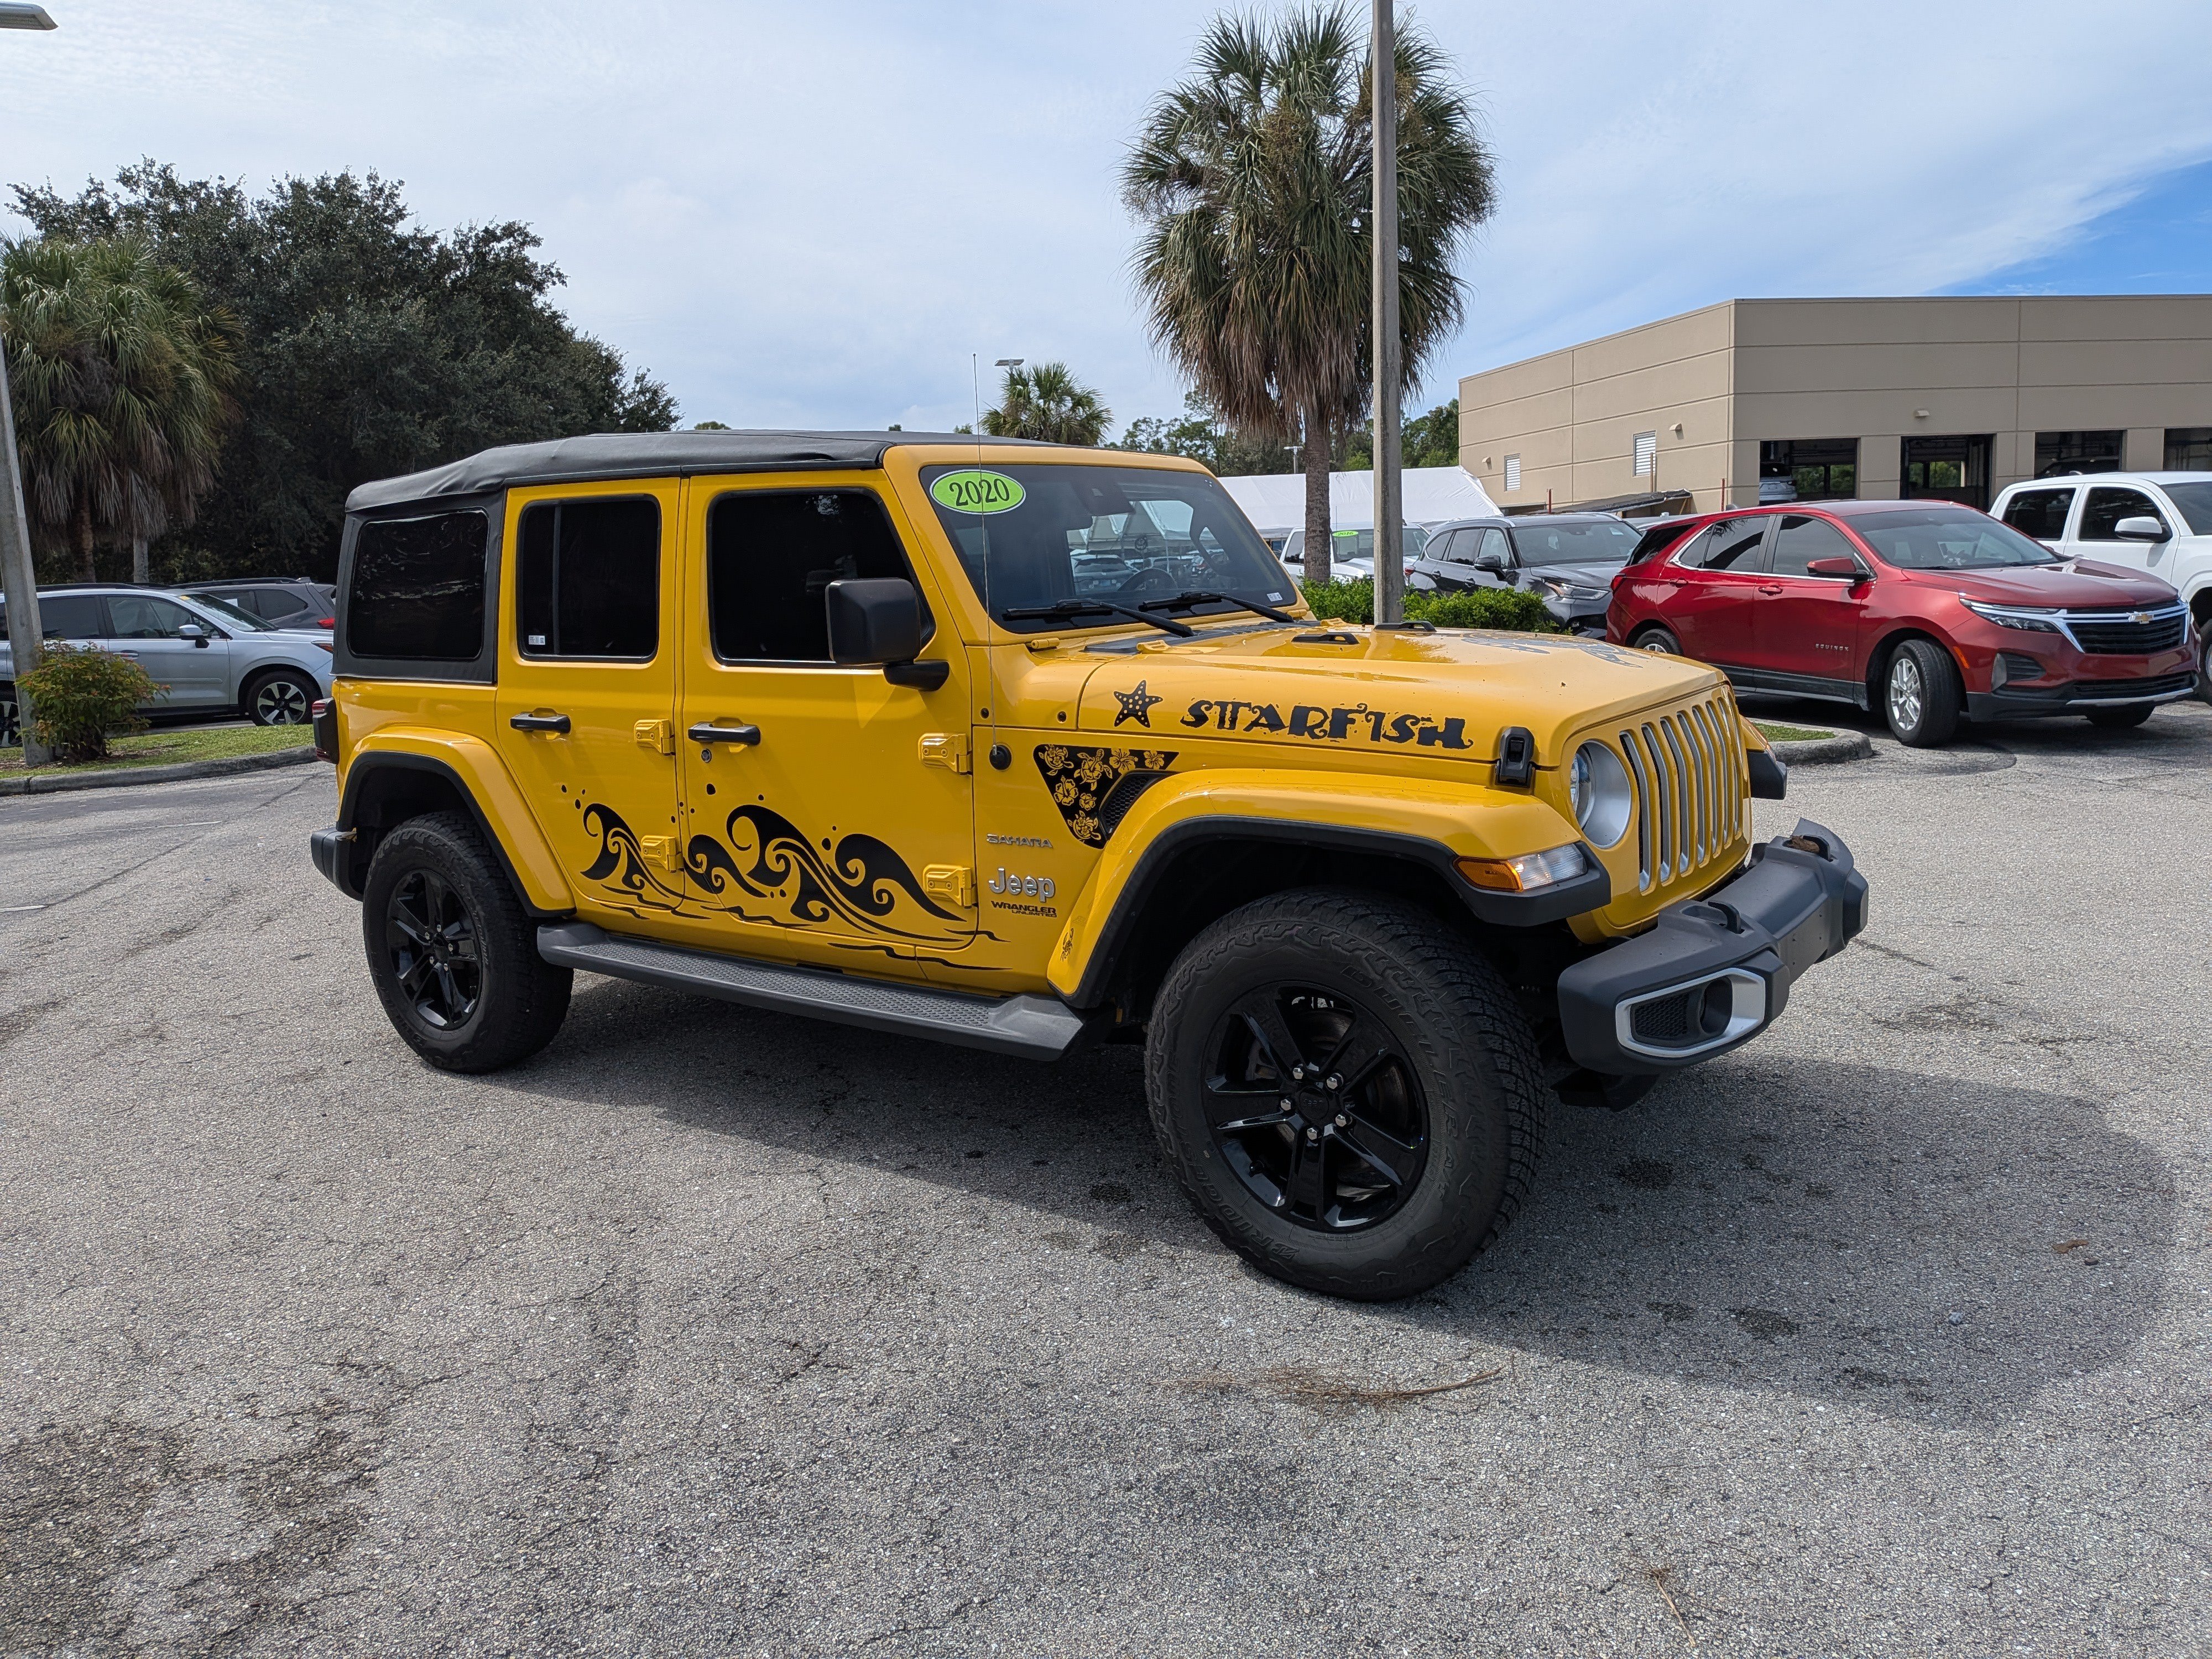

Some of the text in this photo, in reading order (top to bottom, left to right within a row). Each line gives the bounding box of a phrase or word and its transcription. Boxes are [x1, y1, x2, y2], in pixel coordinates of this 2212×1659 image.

[948, 478, 1010, 507] 2020
[1815, 643, 1849, 651] EQUINOX
[1180, 702, 1474, 750] STARFISH
[986, 833, 1053, 849] SAHARA
[988, 867, 1056, 903] Jeep
[990, 900, 1056, 914] WRANGLER
[1011, 909, 1057, 918] UNLIMITED
